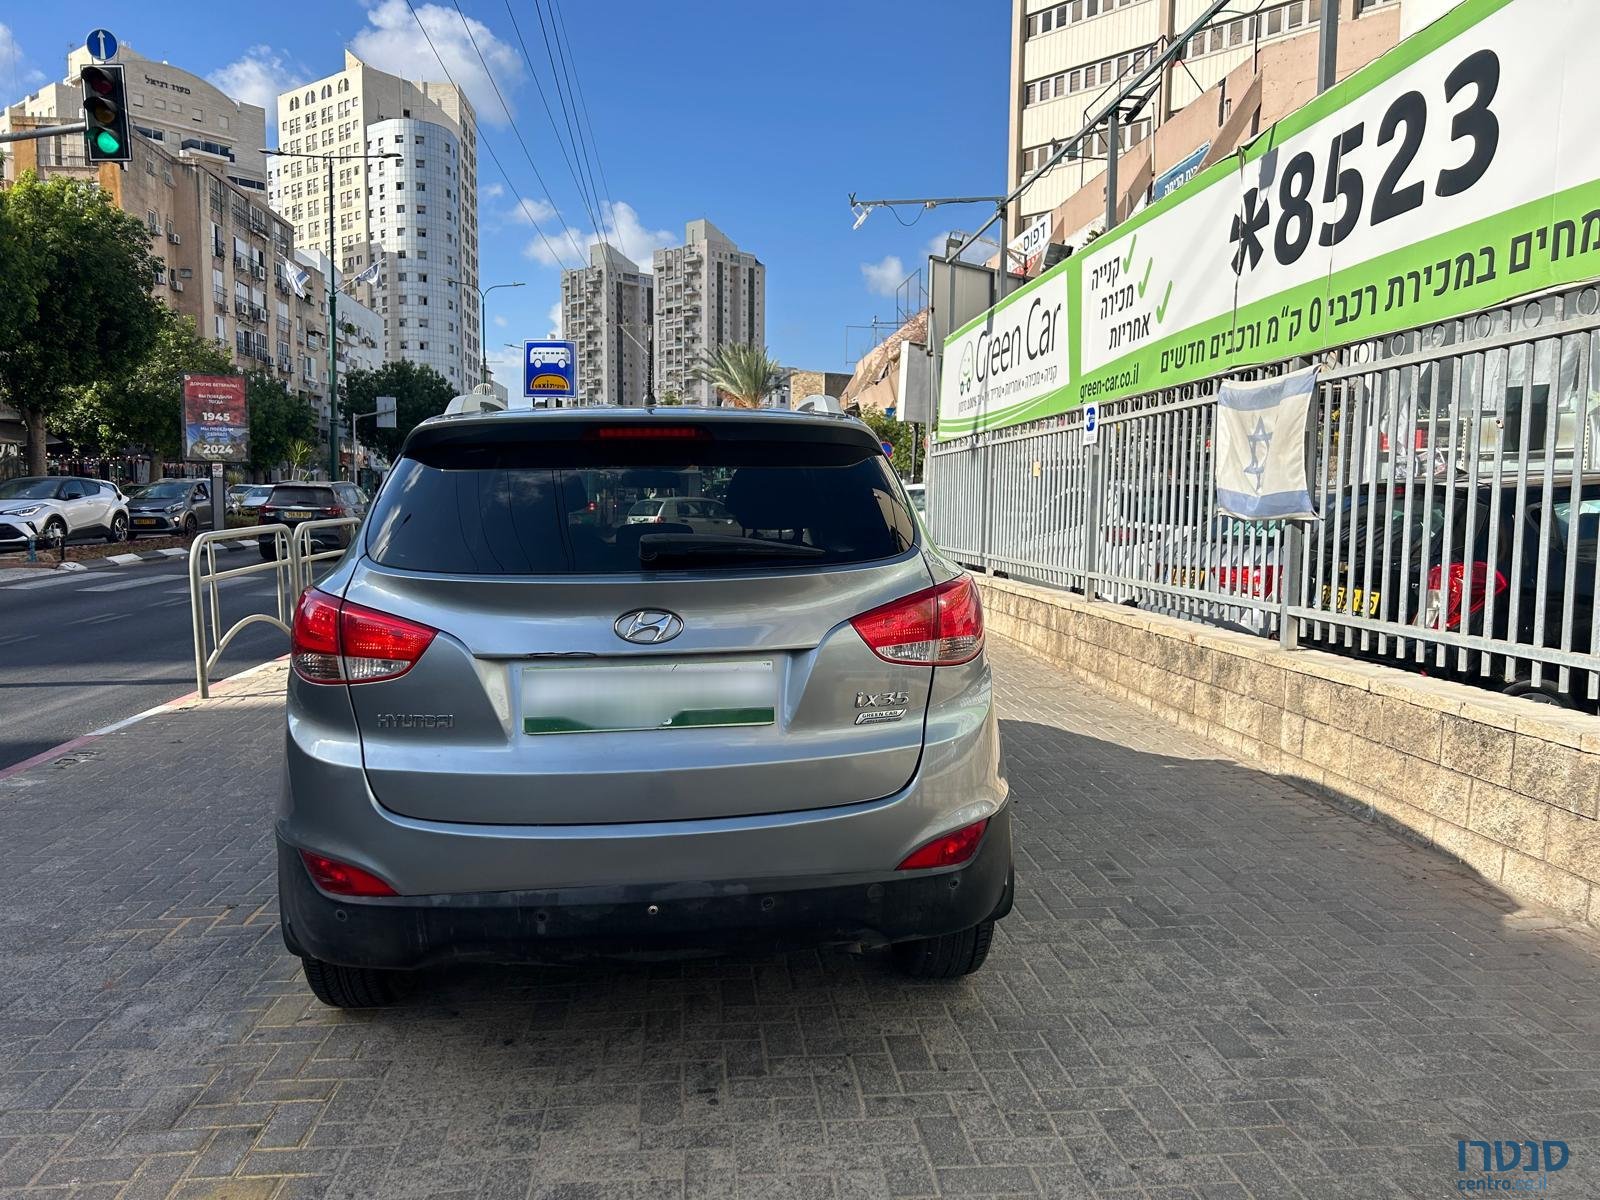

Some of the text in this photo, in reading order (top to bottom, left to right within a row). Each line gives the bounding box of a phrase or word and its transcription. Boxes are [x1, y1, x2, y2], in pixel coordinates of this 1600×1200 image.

[1023, 221, 1046, 252] דפוס
[1091, 256, 1120, 291] קנייה
[1384, 246, 1497, 312] במכירת
[1100, 284, 1134, 320] מכירה
[1328, 284, 1378, 326] רכבי
[976, 297, 1061, 382] Green Car
[1109, 312, 1151, 350] אחריות
[1210, 321, 1261, 360] ורכבים
[1160, 339, 1206, 374] חדשים
[1080, 362, 1140, 403] green-car.co.il
[202, 412, 230, 421] 1945
[203, 444, 234, 454] 2024
[855, 691, 910, 708] ix35
[377, 713, 454, 728] HYUNDAI
